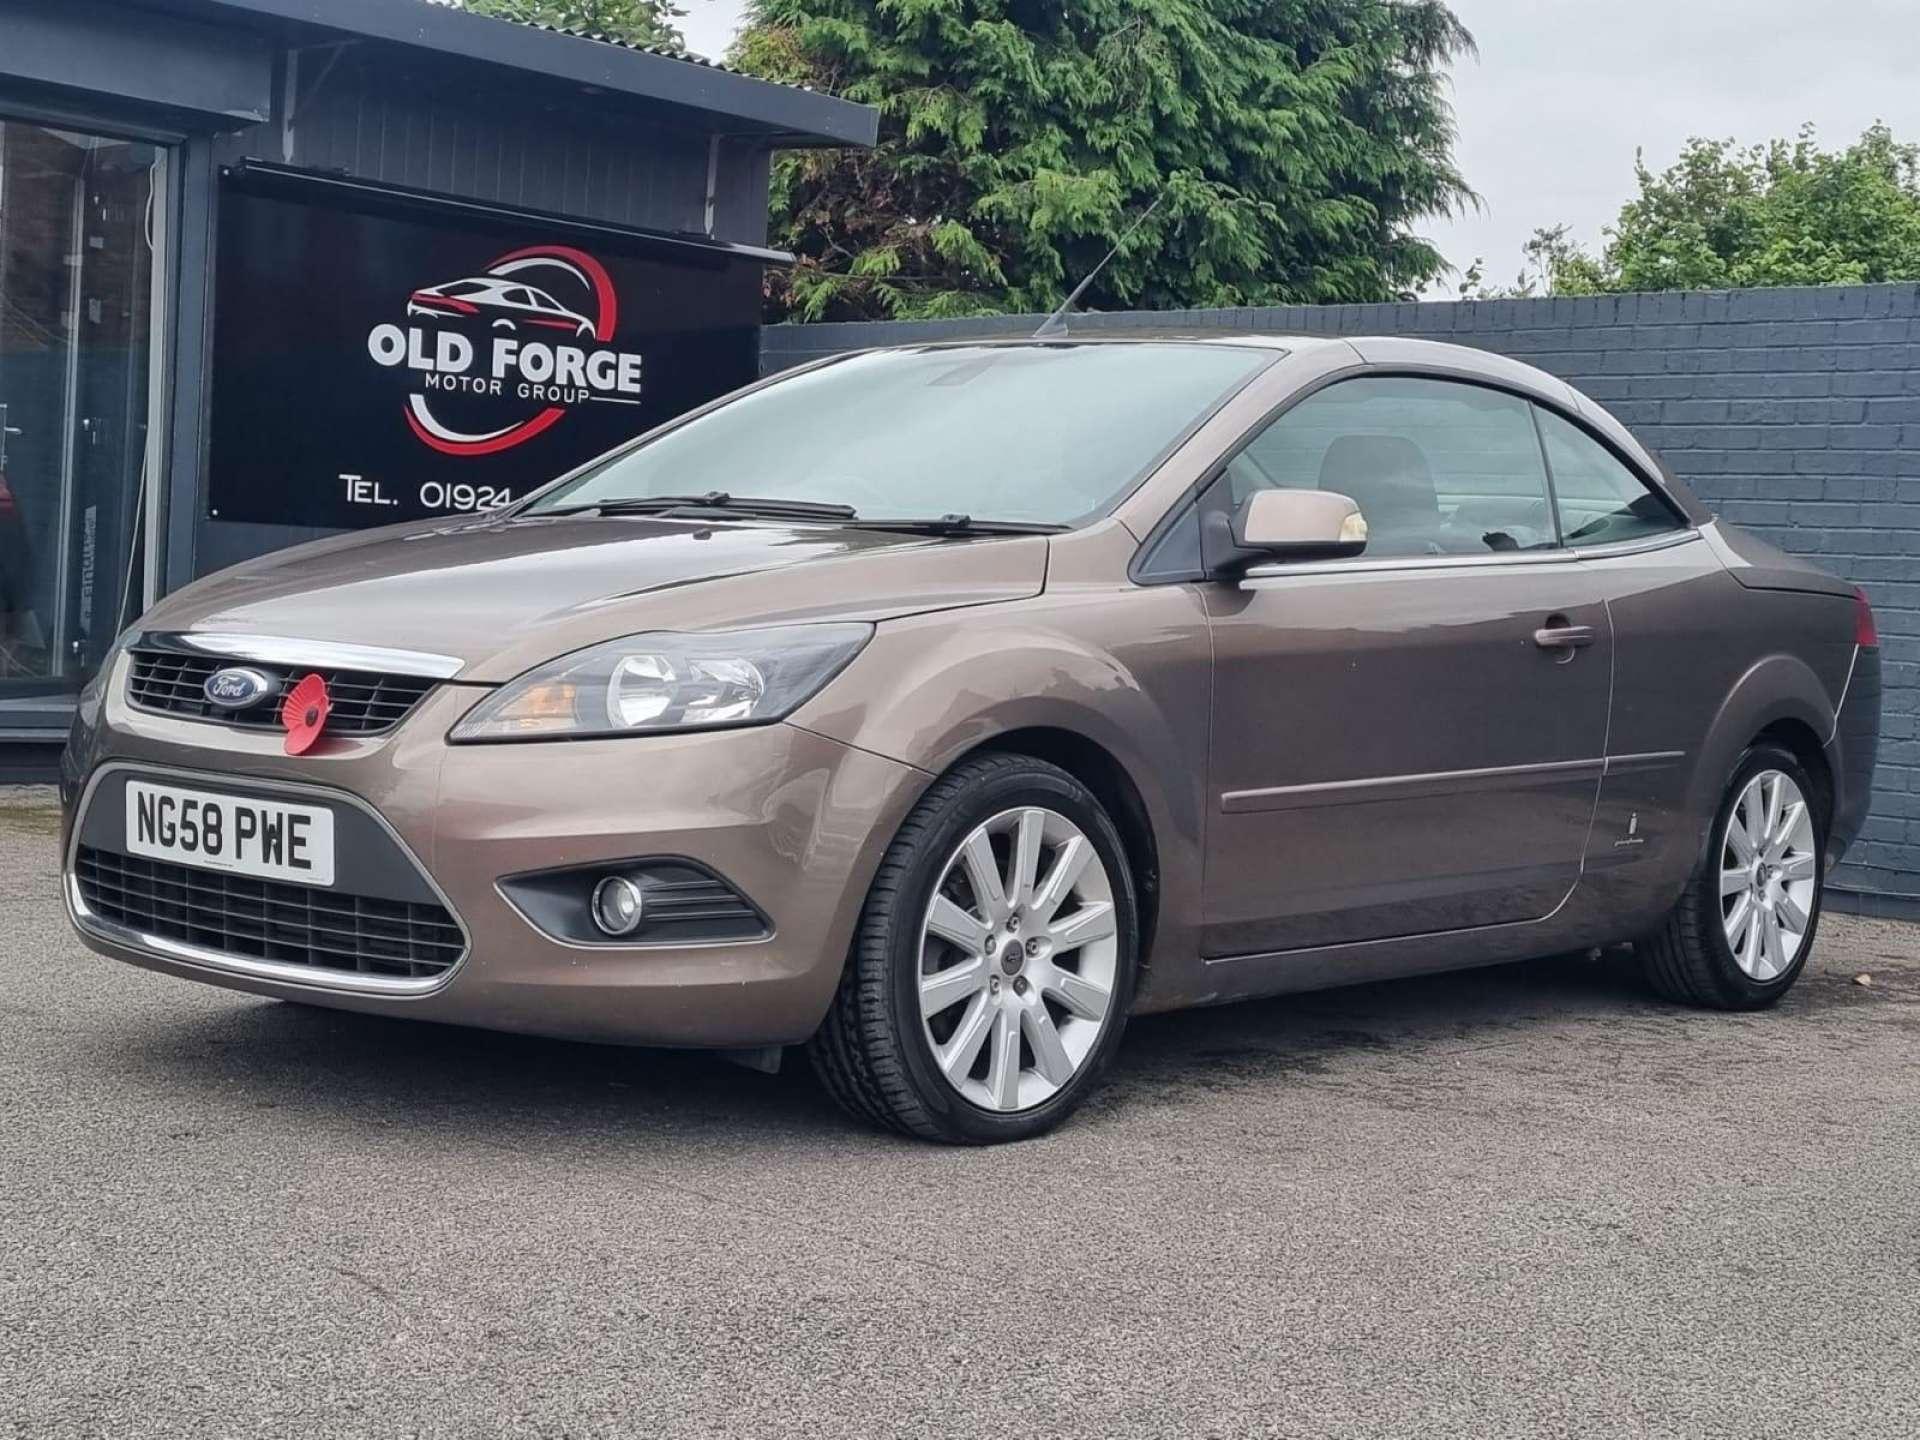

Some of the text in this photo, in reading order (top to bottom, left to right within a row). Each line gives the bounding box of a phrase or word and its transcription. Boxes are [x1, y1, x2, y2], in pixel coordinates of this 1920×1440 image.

[367, 323, 642, 393] OLD FORGE
[425, 372, 590, 403] MOTOR GROUP
[420, 481, 511, 509] 01924
[213, 676, 246, 696] Ford
[137, 791, 312, 870] NG58 PWE
